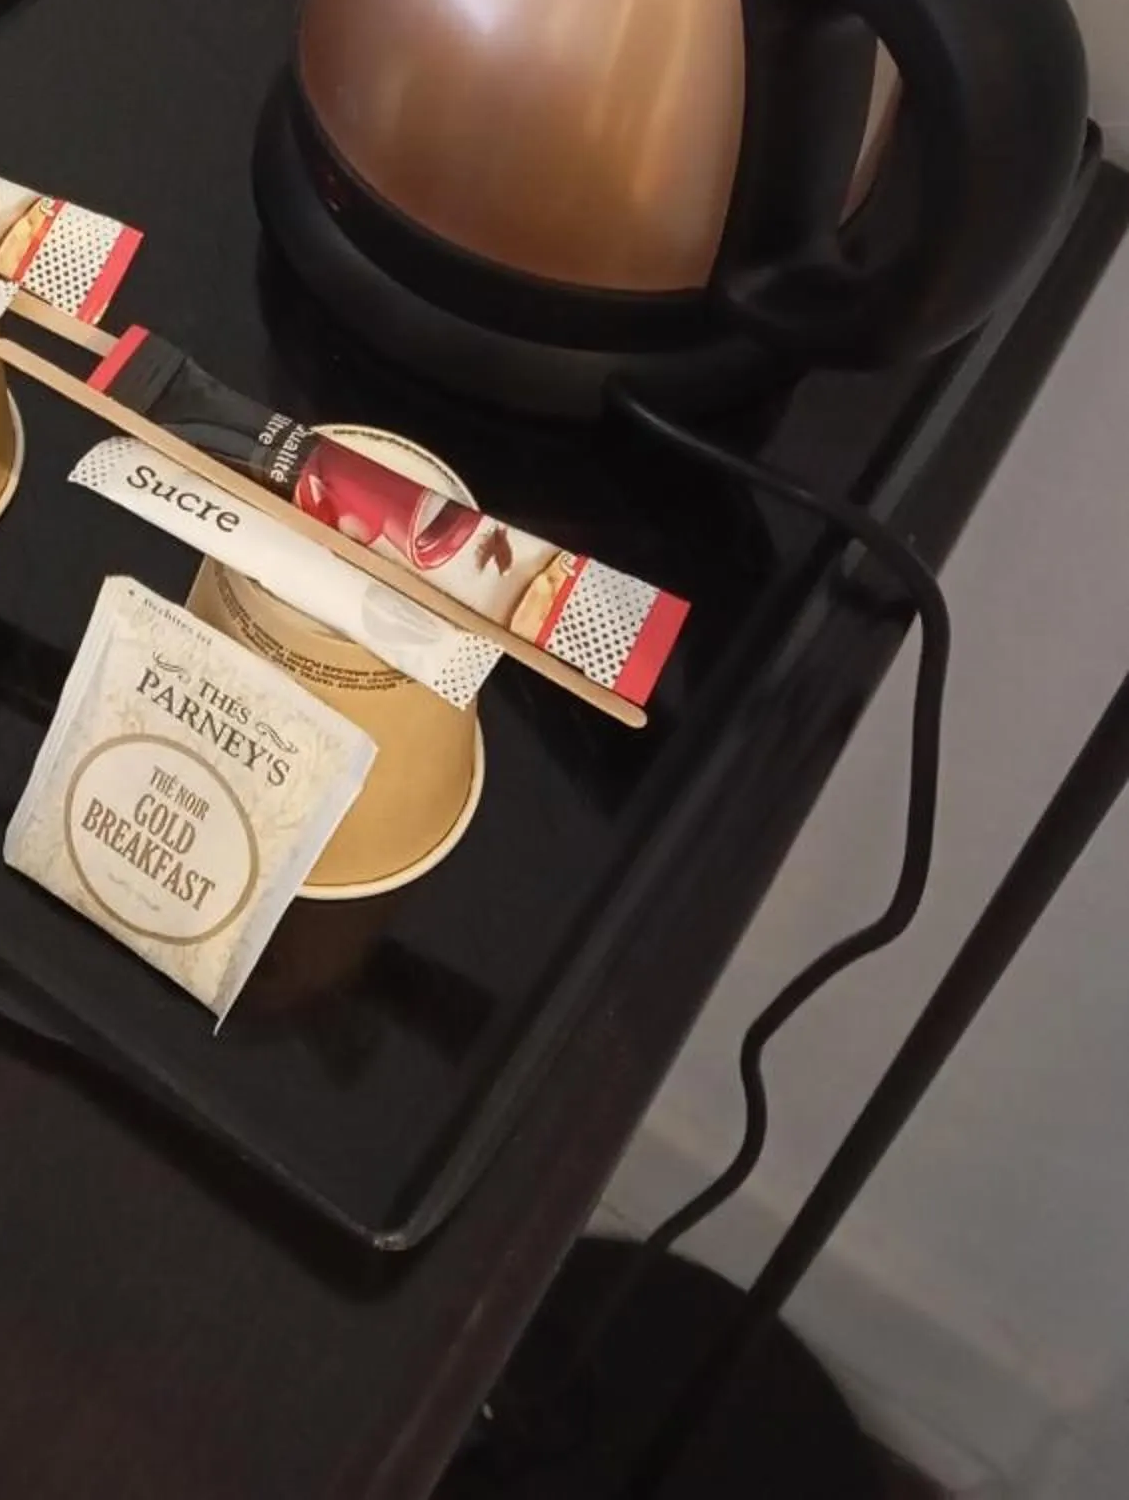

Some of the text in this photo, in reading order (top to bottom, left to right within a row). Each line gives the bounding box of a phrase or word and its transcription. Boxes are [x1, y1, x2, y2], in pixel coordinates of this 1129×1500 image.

[126, 465, 241, 533] Sucre
[136, 667, 291, 787] PARNEY'S
[133, 793, 197, 855] GOLD
[175, 784, 210, 821] NOIR
[81, 797, 216, 912] BREAKFAST
